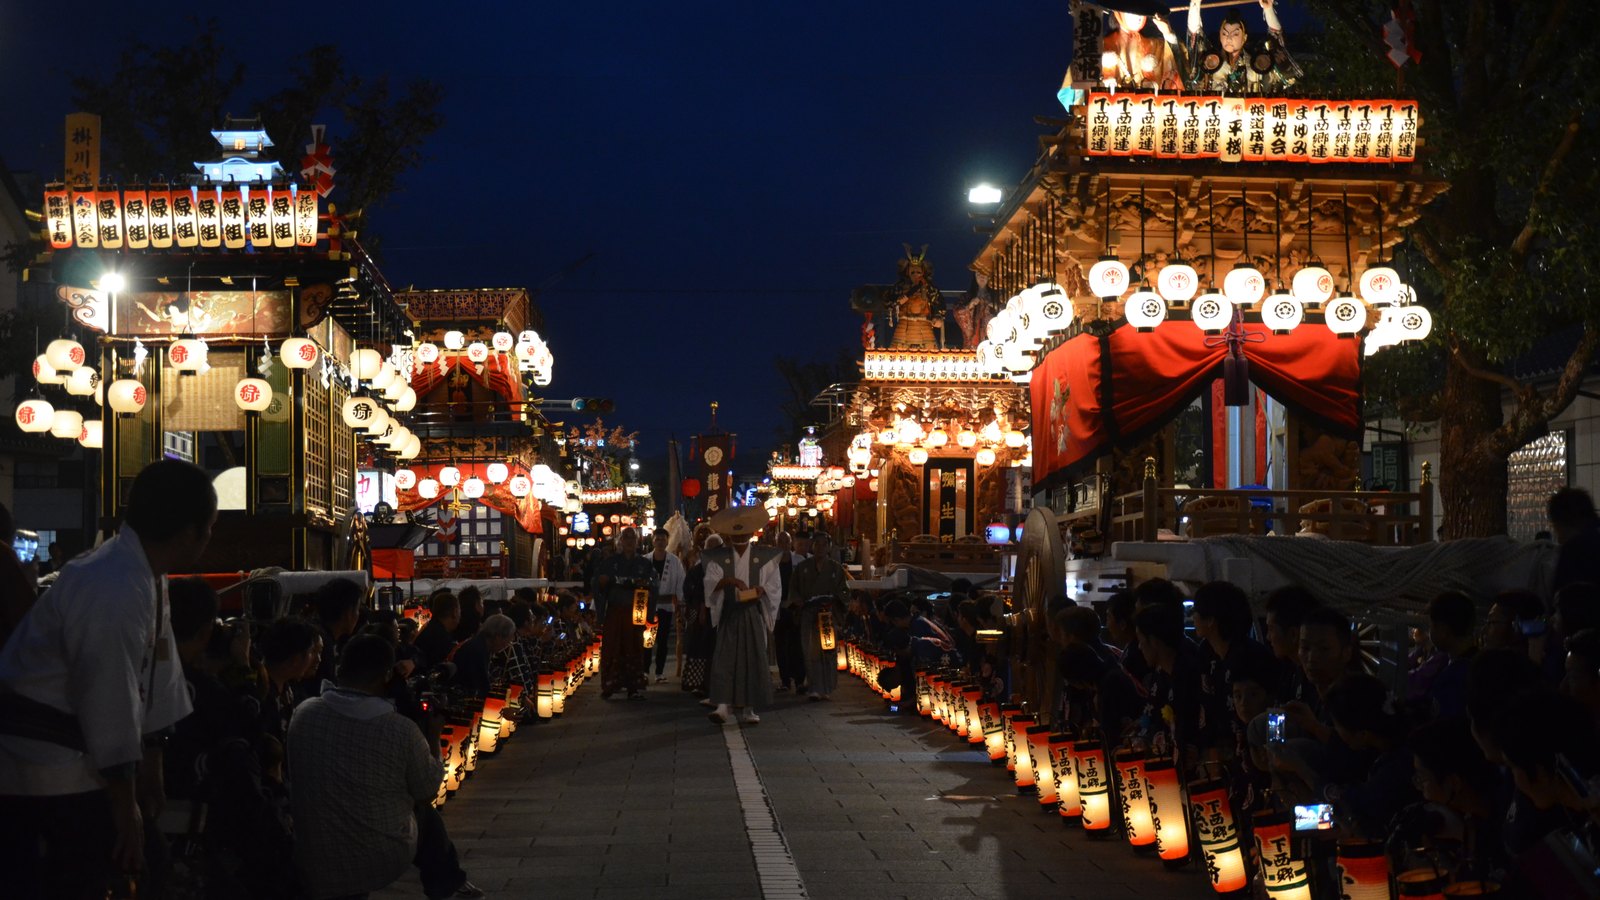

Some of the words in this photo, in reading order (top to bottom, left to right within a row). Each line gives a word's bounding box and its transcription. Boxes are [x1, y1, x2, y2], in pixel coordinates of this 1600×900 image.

[1091, 98, 1110, 151] 下西郷連
[1113, 98, 1133, 151] 下西郷連
[1138, 98, 1156, 151] 下西郷連
[1161, 100, 1178, 154] 下西郷連
[1182, 101, 1200, 154] 下西郷連
[1202, 101, 1221, 154] 下西郷連
[1292, 105, 1309, 156] まゆみ
[1312, 105, 1331, 158] 下西郷連
[1334, 105, 1352, 158] 下西郷連
[1354, 105, 1373, 158] 下西郷連
[1376, 105, 1395, 158] 下西郷連
[1397, 105, 1417, 158] 下西郷連
[1085, 757, 1100, 788] 下西郷
[1126, 767, 1142, 800] 下西郷
[1207, 800, 1228, 840] 下西郷
[1270, 836, 1294, 883] 下西郷
